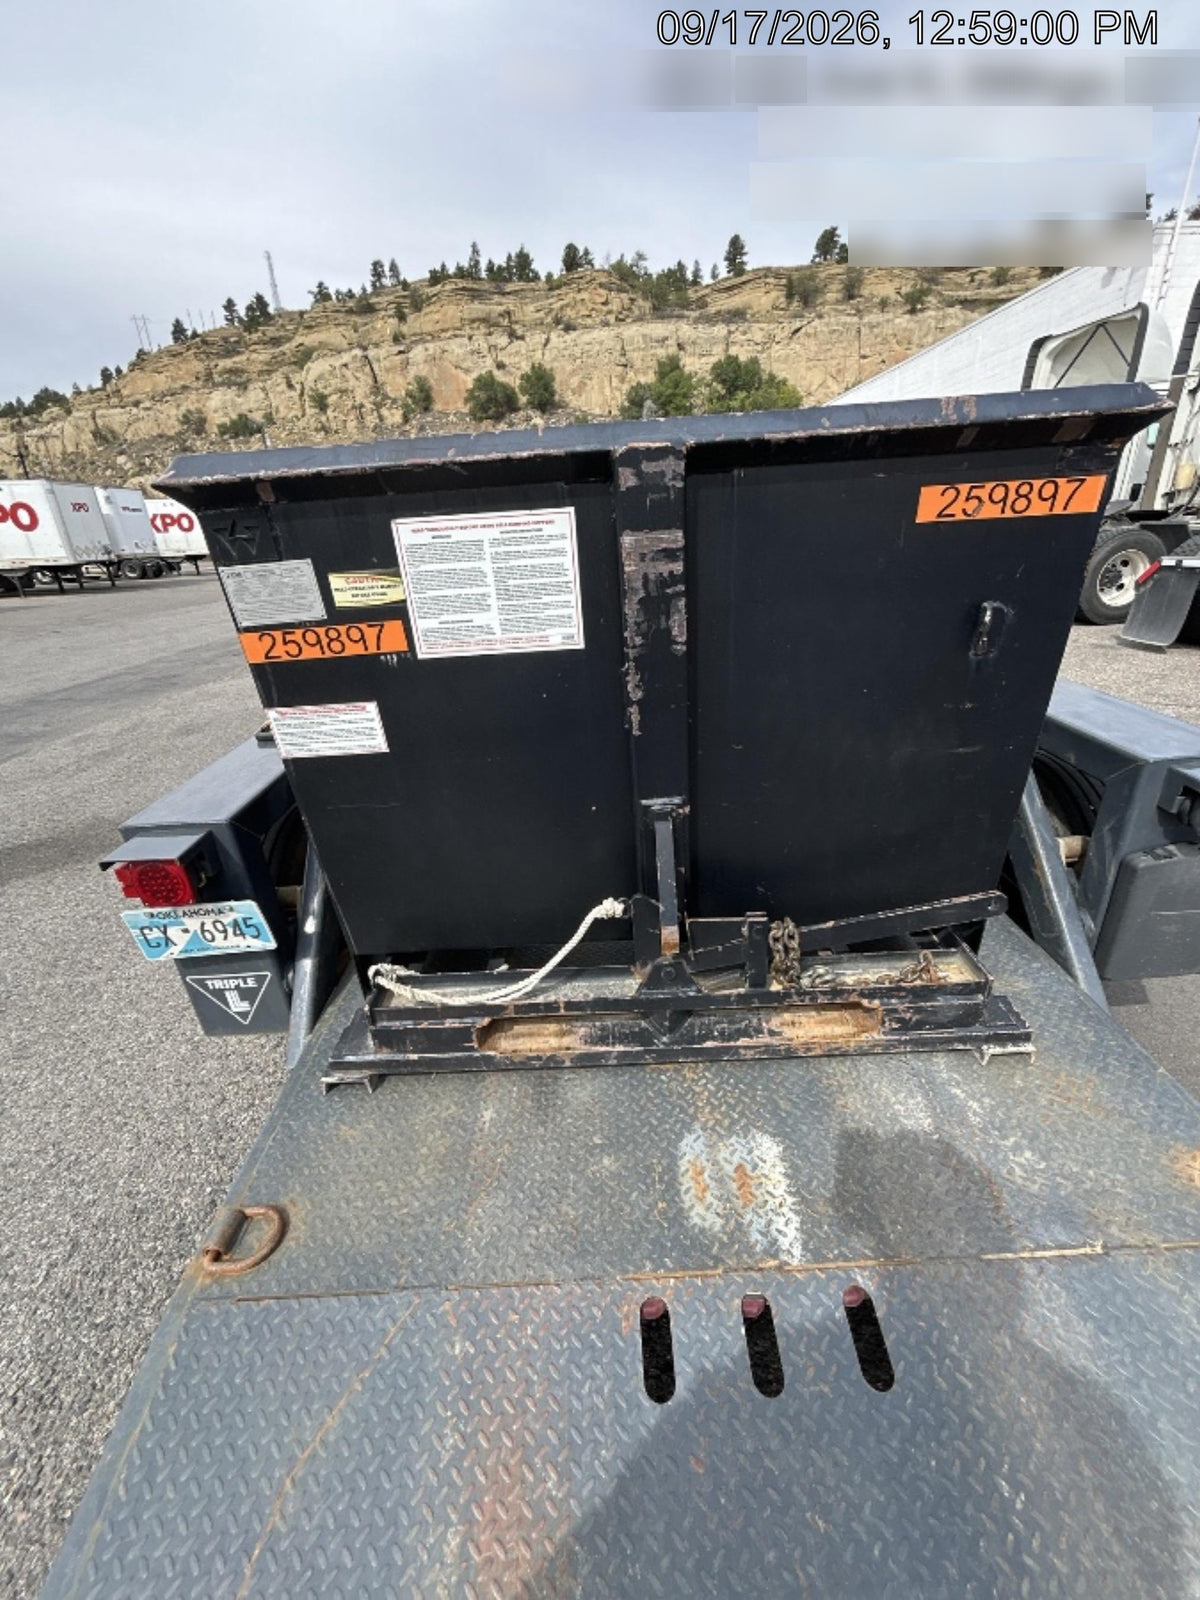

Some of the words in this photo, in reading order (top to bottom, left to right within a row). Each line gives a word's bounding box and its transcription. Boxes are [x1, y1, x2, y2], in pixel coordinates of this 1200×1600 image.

[935, 478, 1088, 519] 259897
[70, 502, 90, 513] XPO
[344, 576, 384, 585] CAUTI
[257, 622, 386, 661] 259897
[155, 907, 227, 920] OKLAHOMA
[139, 925, 178, 949] CX
[199, 917, 261, 943] 6945
[204, 977, 258, 990] TRIPLE
